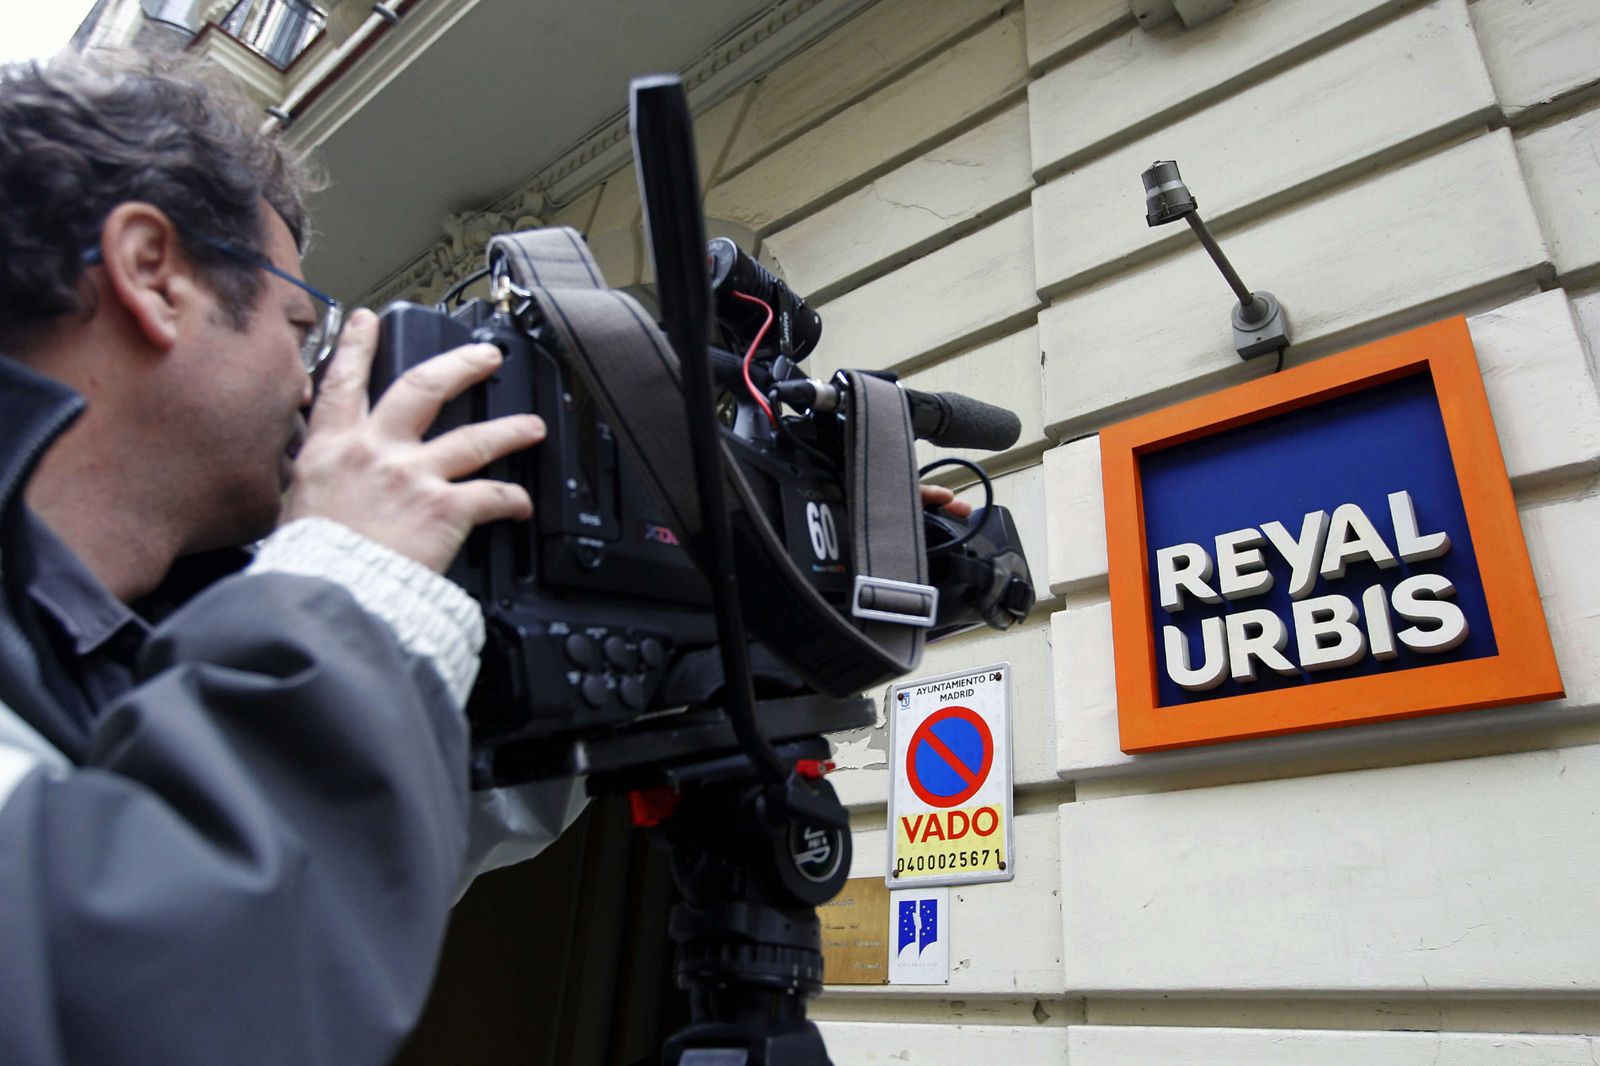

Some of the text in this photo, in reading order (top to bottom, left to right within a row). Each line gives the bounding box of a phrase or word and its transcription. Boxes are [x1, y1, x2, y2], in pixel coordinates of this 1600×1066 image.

[806, 501, 839, 560] 60
[1156, 490, 1450, 613] REYAL
[1163, 573, 1469, 692] URBIS
[916, 673, 1002, 696] AYUNTAMIENTO D
[940, 689, 975, 702] MADRID
[901, 806, 999, 844] VADO
[897, 848, 1000, 872] 0400025671
